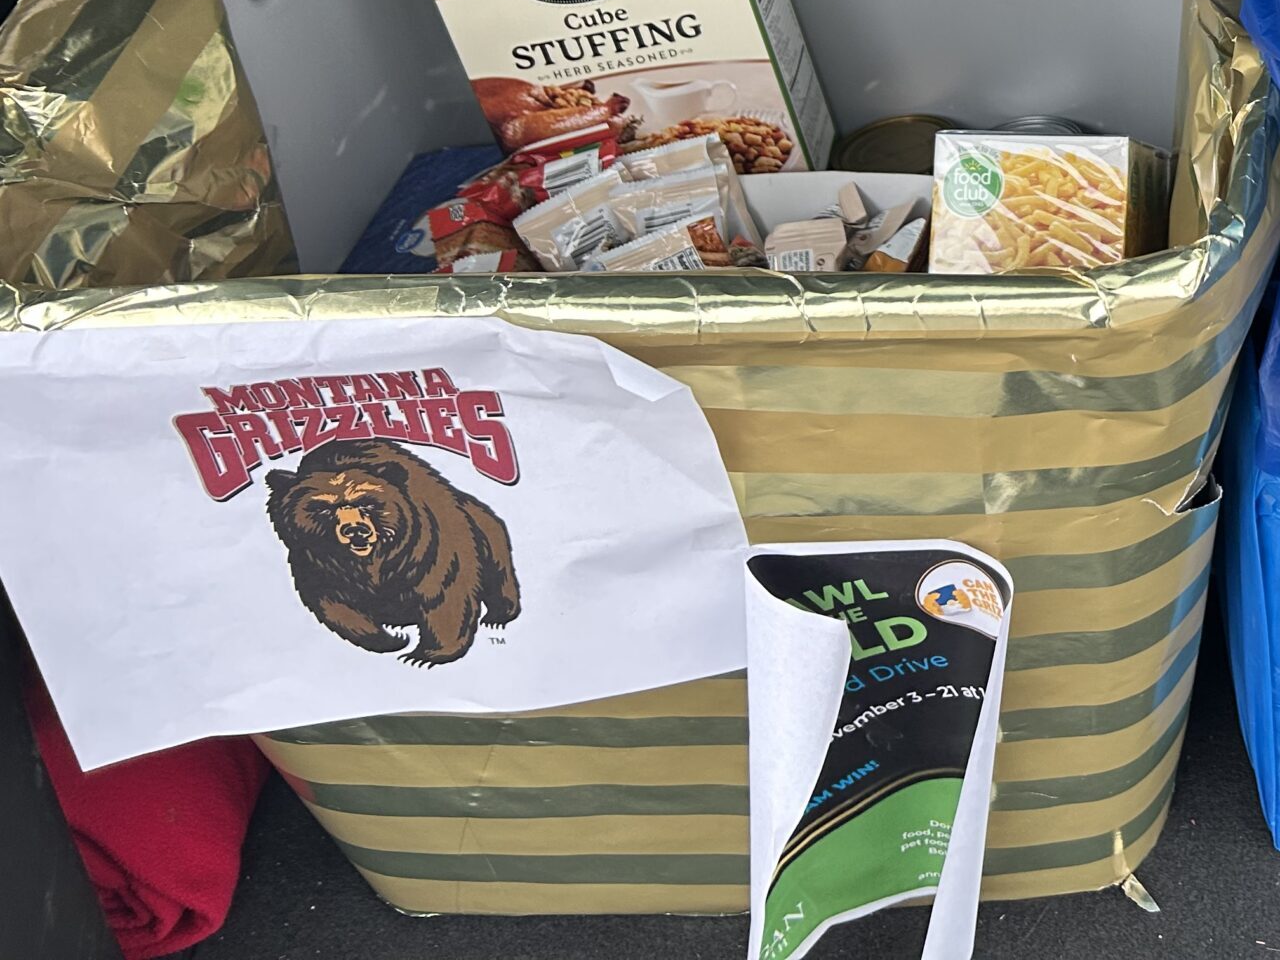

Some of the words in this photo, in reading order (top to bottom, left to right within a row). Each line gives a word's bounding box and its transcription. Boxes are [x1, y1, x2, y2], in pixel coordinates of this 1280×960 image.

[563, 7, 629, 30] Cube
[511, 13, 702, 70] STUFFING
[553, 65, 592, 80] HERB
[599, 48, 678, 73] SEASONED
[954, 171, 991, 185] food
[953, 183, 989, 201] club
[200, 367, 460, 415] MONTANA
[172, 389, 521, 503] GRIZZLIES
[962, 578, 994, 593] CAN
[967, 589, 999, 606] THE
[488, 637, 506, 645] TM
[869, 654, 950, 682] Drive
[830, 698, 906, 743] vember
[906, 691, 923, 703] 3
[937, 685, 958, 698] 21
[960, 685, 981, 700] at
[832, 760, 880, 791] WIN!
[901, 840, 922, 852] pet
